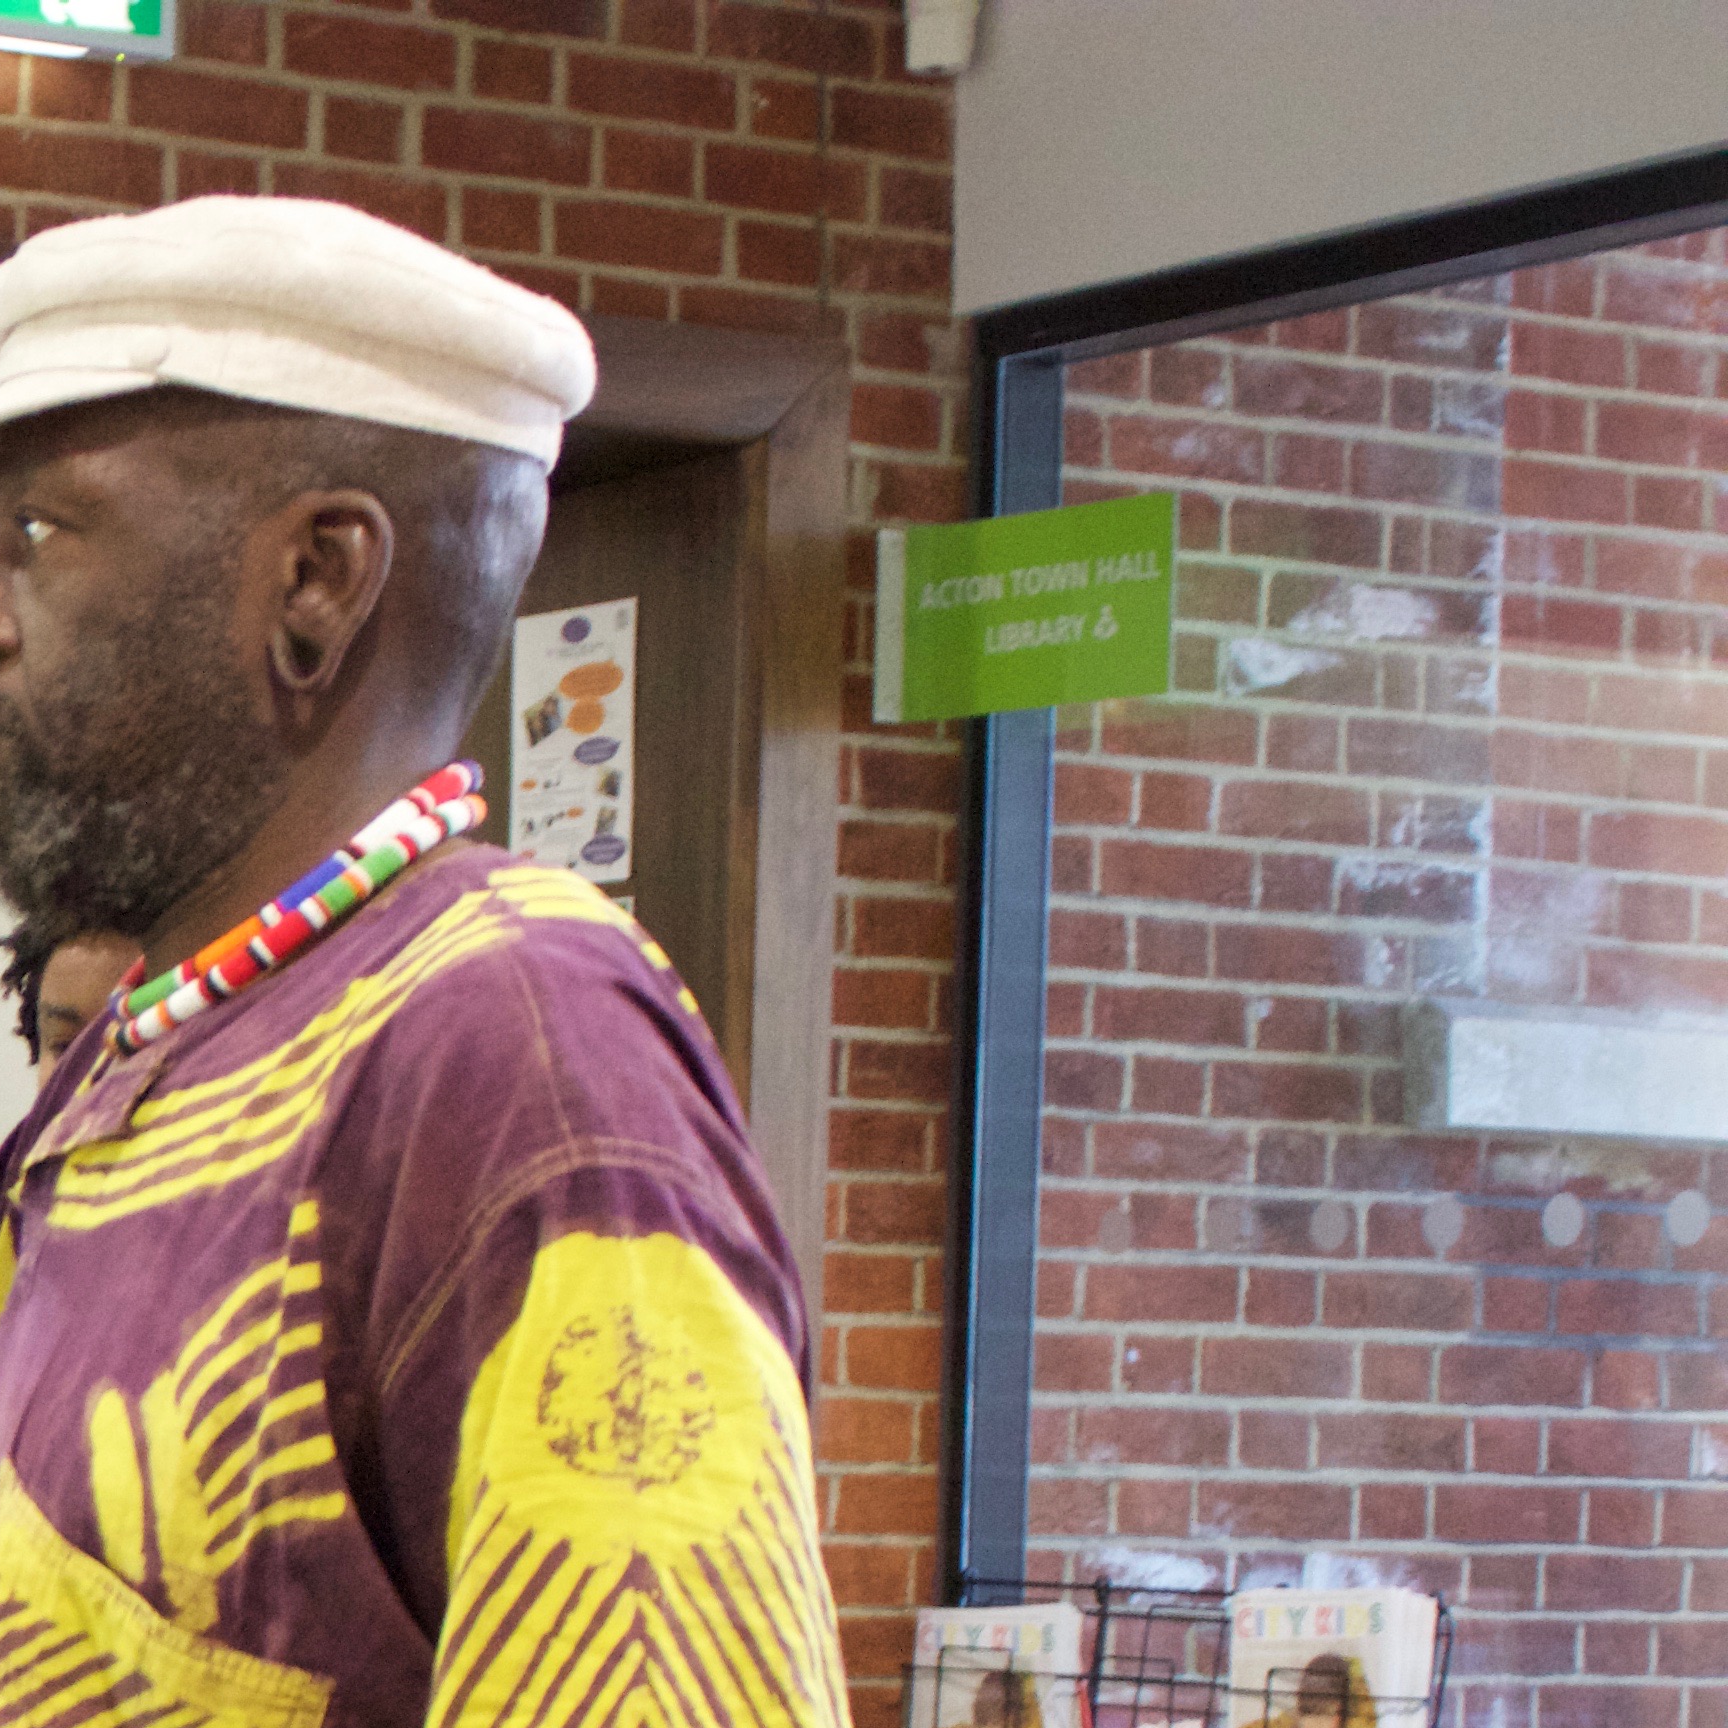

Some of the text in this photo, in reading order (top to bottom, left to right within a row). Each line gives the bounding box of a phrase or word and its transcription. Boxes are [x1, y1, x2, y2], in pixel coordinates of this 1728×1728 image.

[918, 550, 1161, 611] ACTON TOWN HALL
[984, 613, 1088, 655] LIBRARY
[992, 1622, 1055, 1656] KIDS
[1235, 1602, 1384, 1638] CITY KIDS
